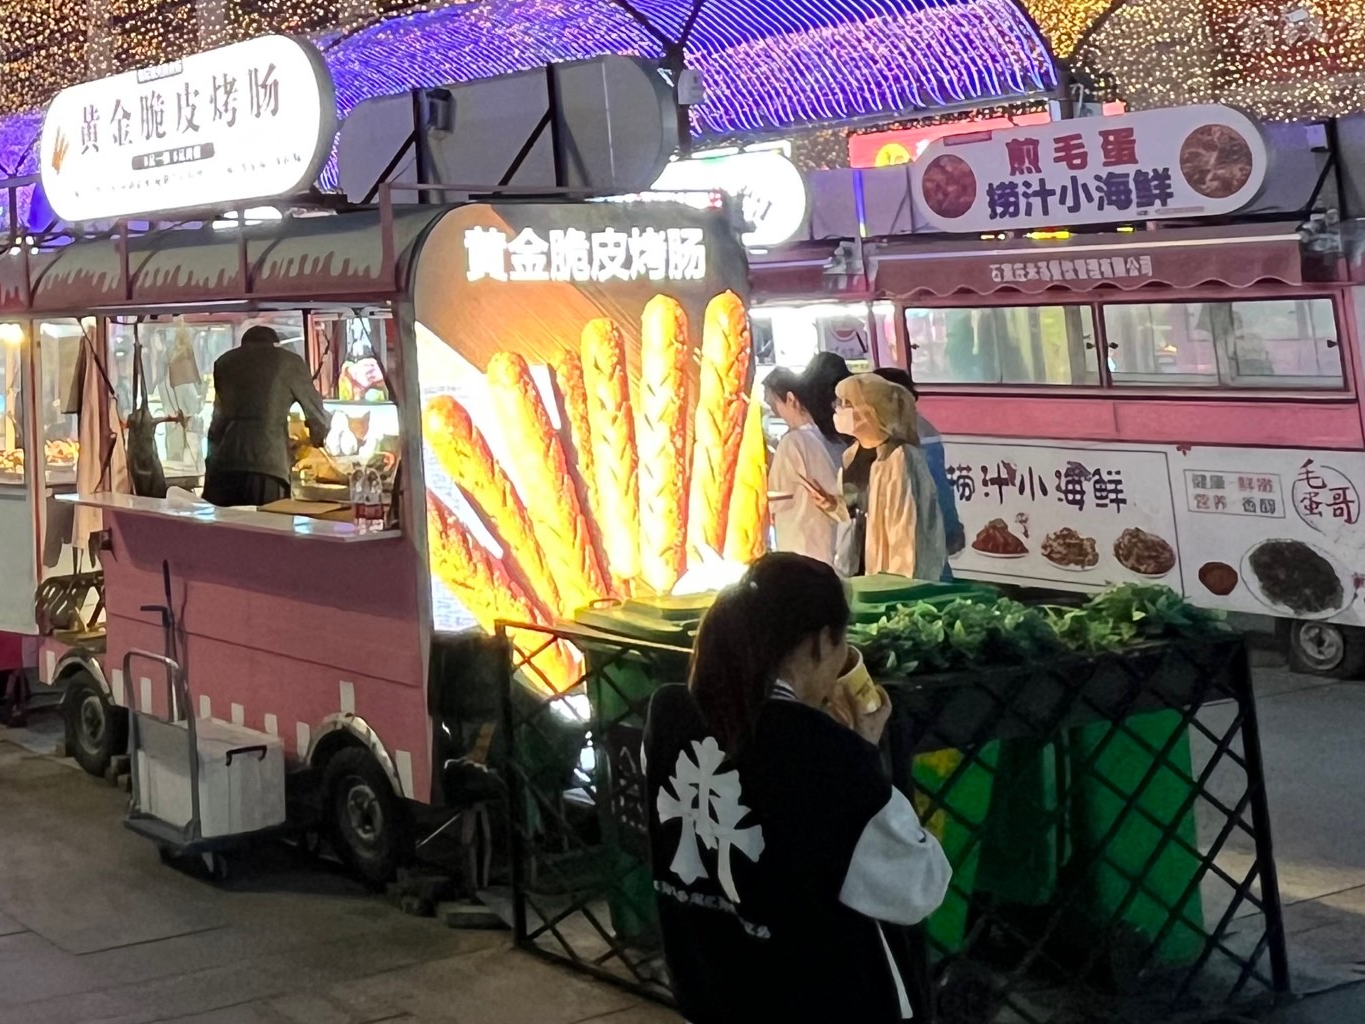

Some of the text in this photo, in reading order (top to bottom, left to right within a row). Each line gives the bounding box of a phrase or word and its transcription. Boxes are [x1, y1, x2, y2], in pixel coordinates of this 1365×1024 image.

[80, 62, 281, 155] 黄金脆皮烤肠
[1005, 128, 1140, 177] 煎毛蛋
[987, 167, 1175, 220] 捞汁小海鲜
[463, 225, 707, 283] 黄金脆皮烤肠
[946, 460, 1128, 514] 捞汁小海鲜
